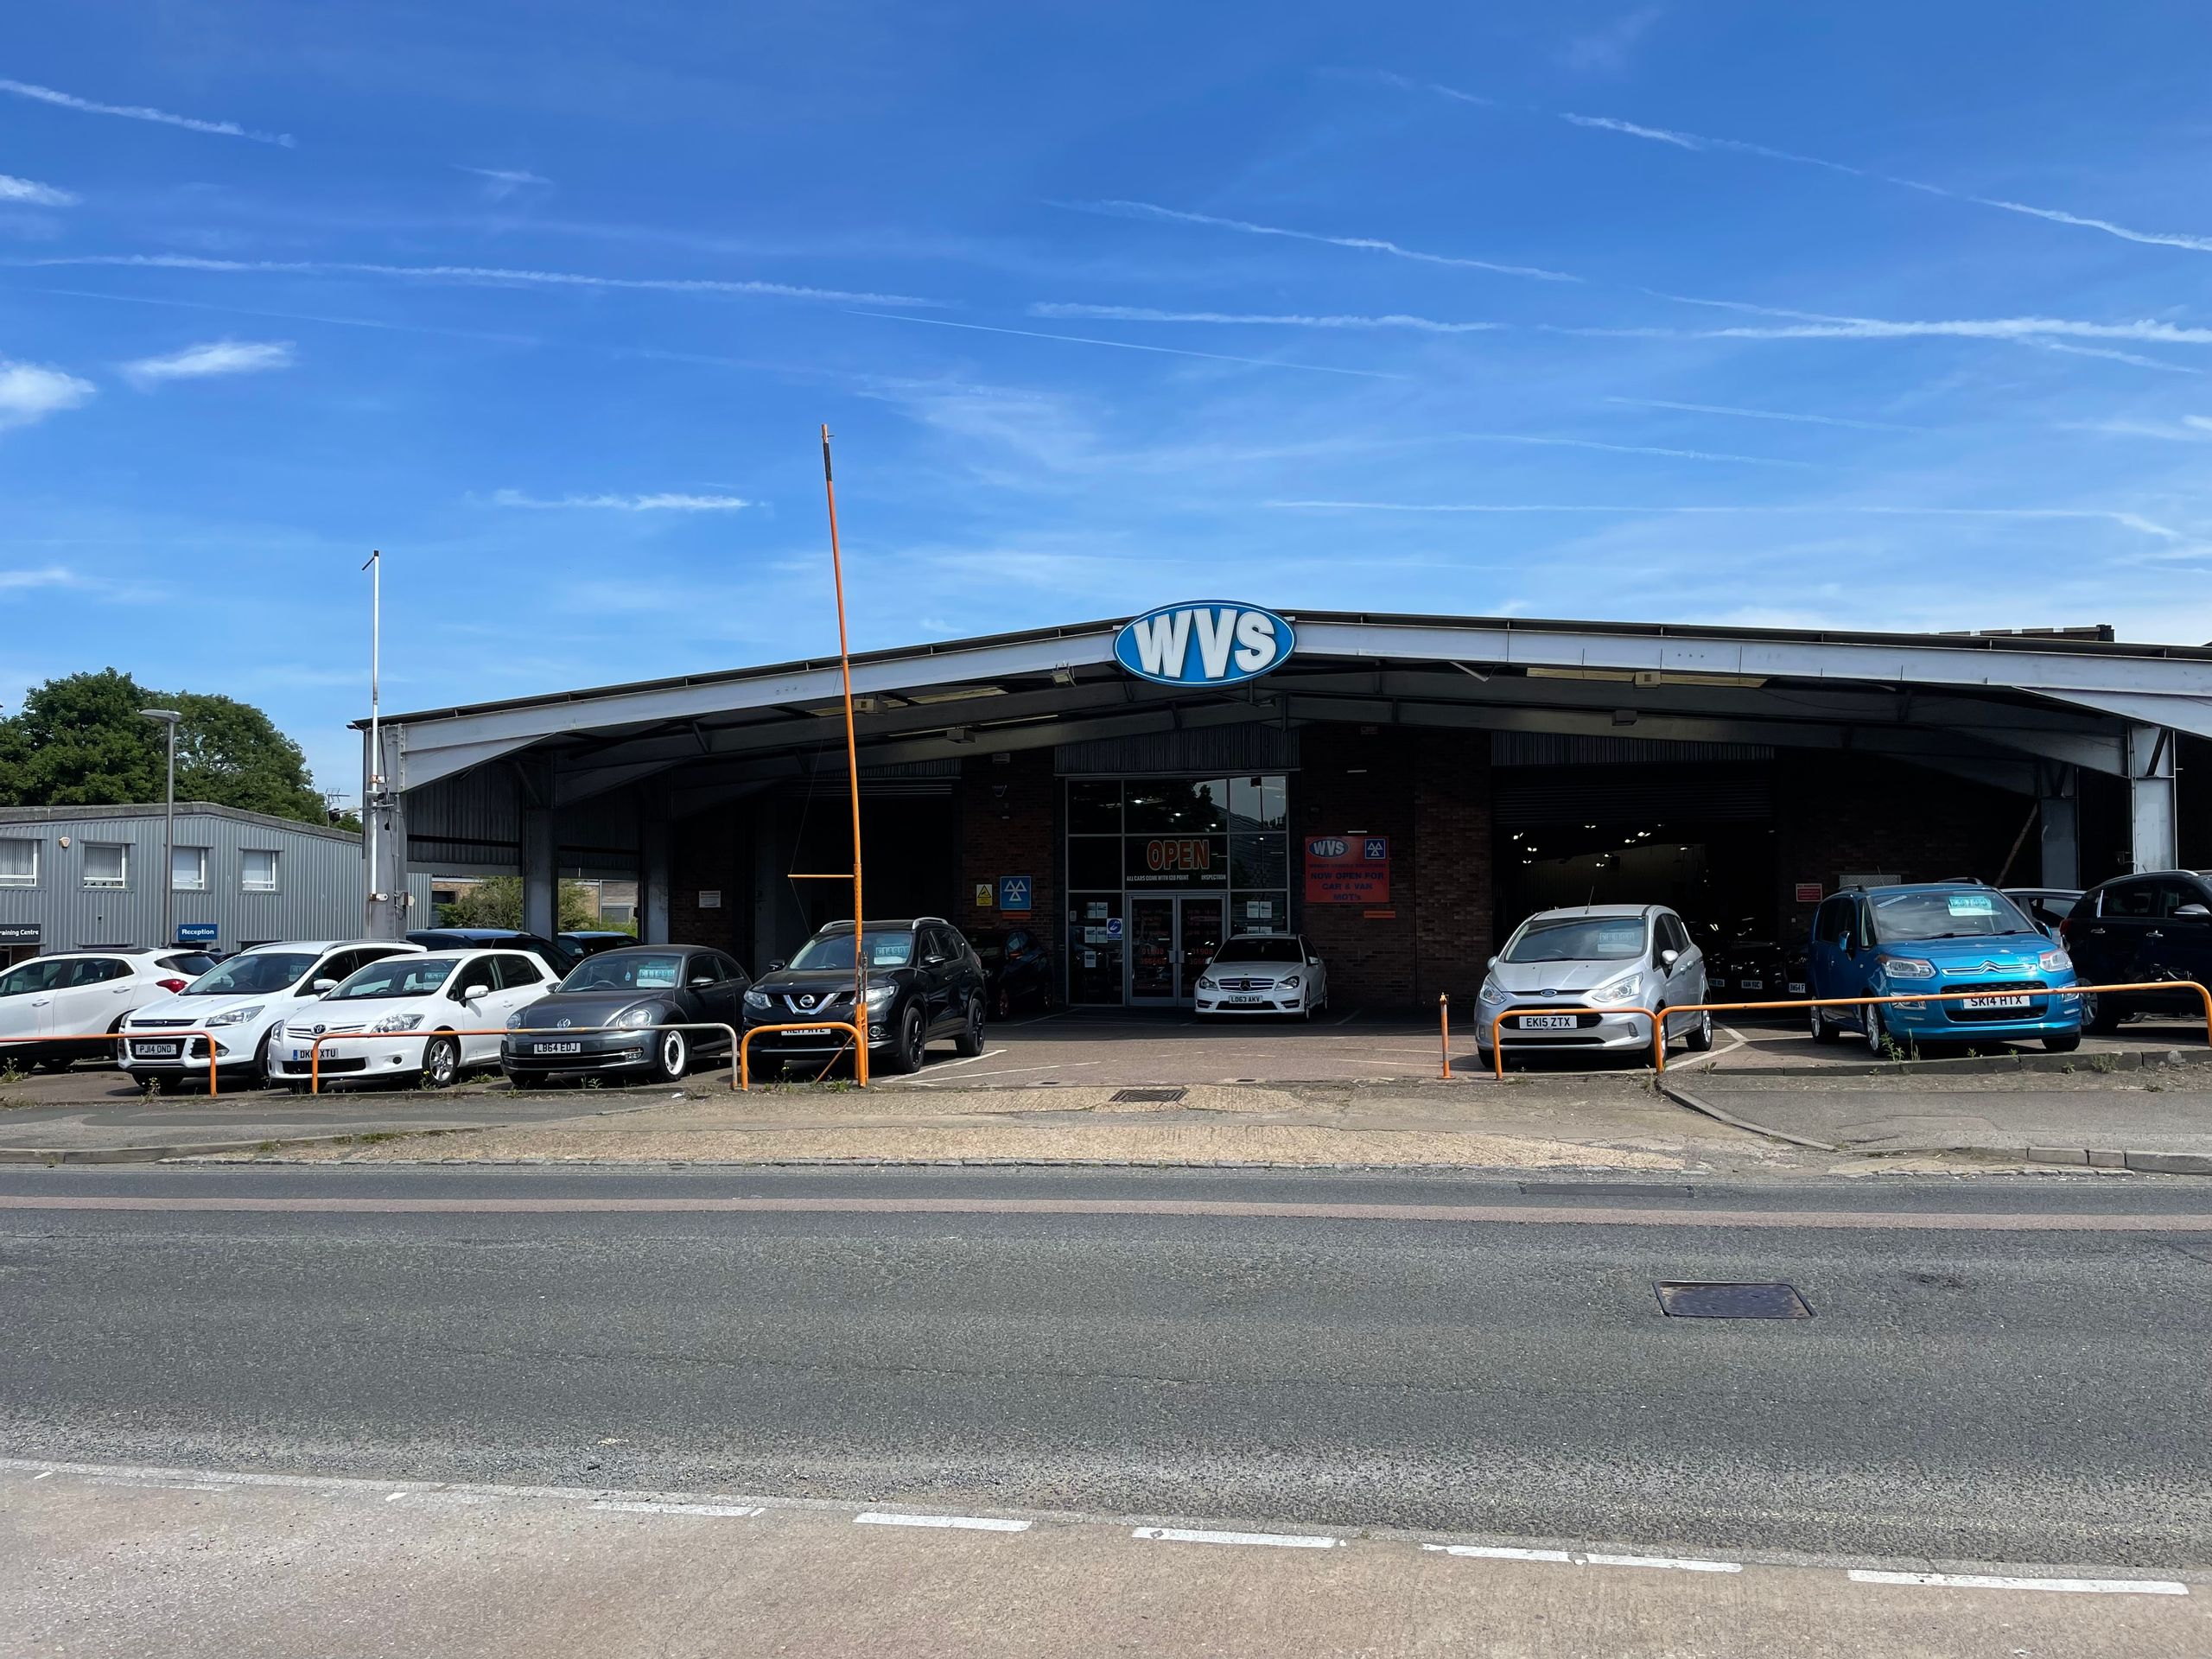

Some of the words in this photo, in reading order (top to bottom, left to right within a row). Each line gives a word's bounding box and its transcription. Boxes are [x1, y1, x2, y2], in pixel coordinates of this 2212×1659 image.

[1132, 607, 1277, 679] WVS
[1313, 840, 1344, 856] WVS
[1147, 839, 1210, 871] OPEN
[1970, 996, 1997, 1007] SK14
[1999, 995, 2022, 1006] HTX
[1526, 1017, 1548, 1027] EK15
[1550, 1017, 1570, 1027] ZTX
[139, 1045, 155, 1053] PJ14
[320, 1048, 336, 1058] XTU
[537, 1043, 558, 1052] LB64
